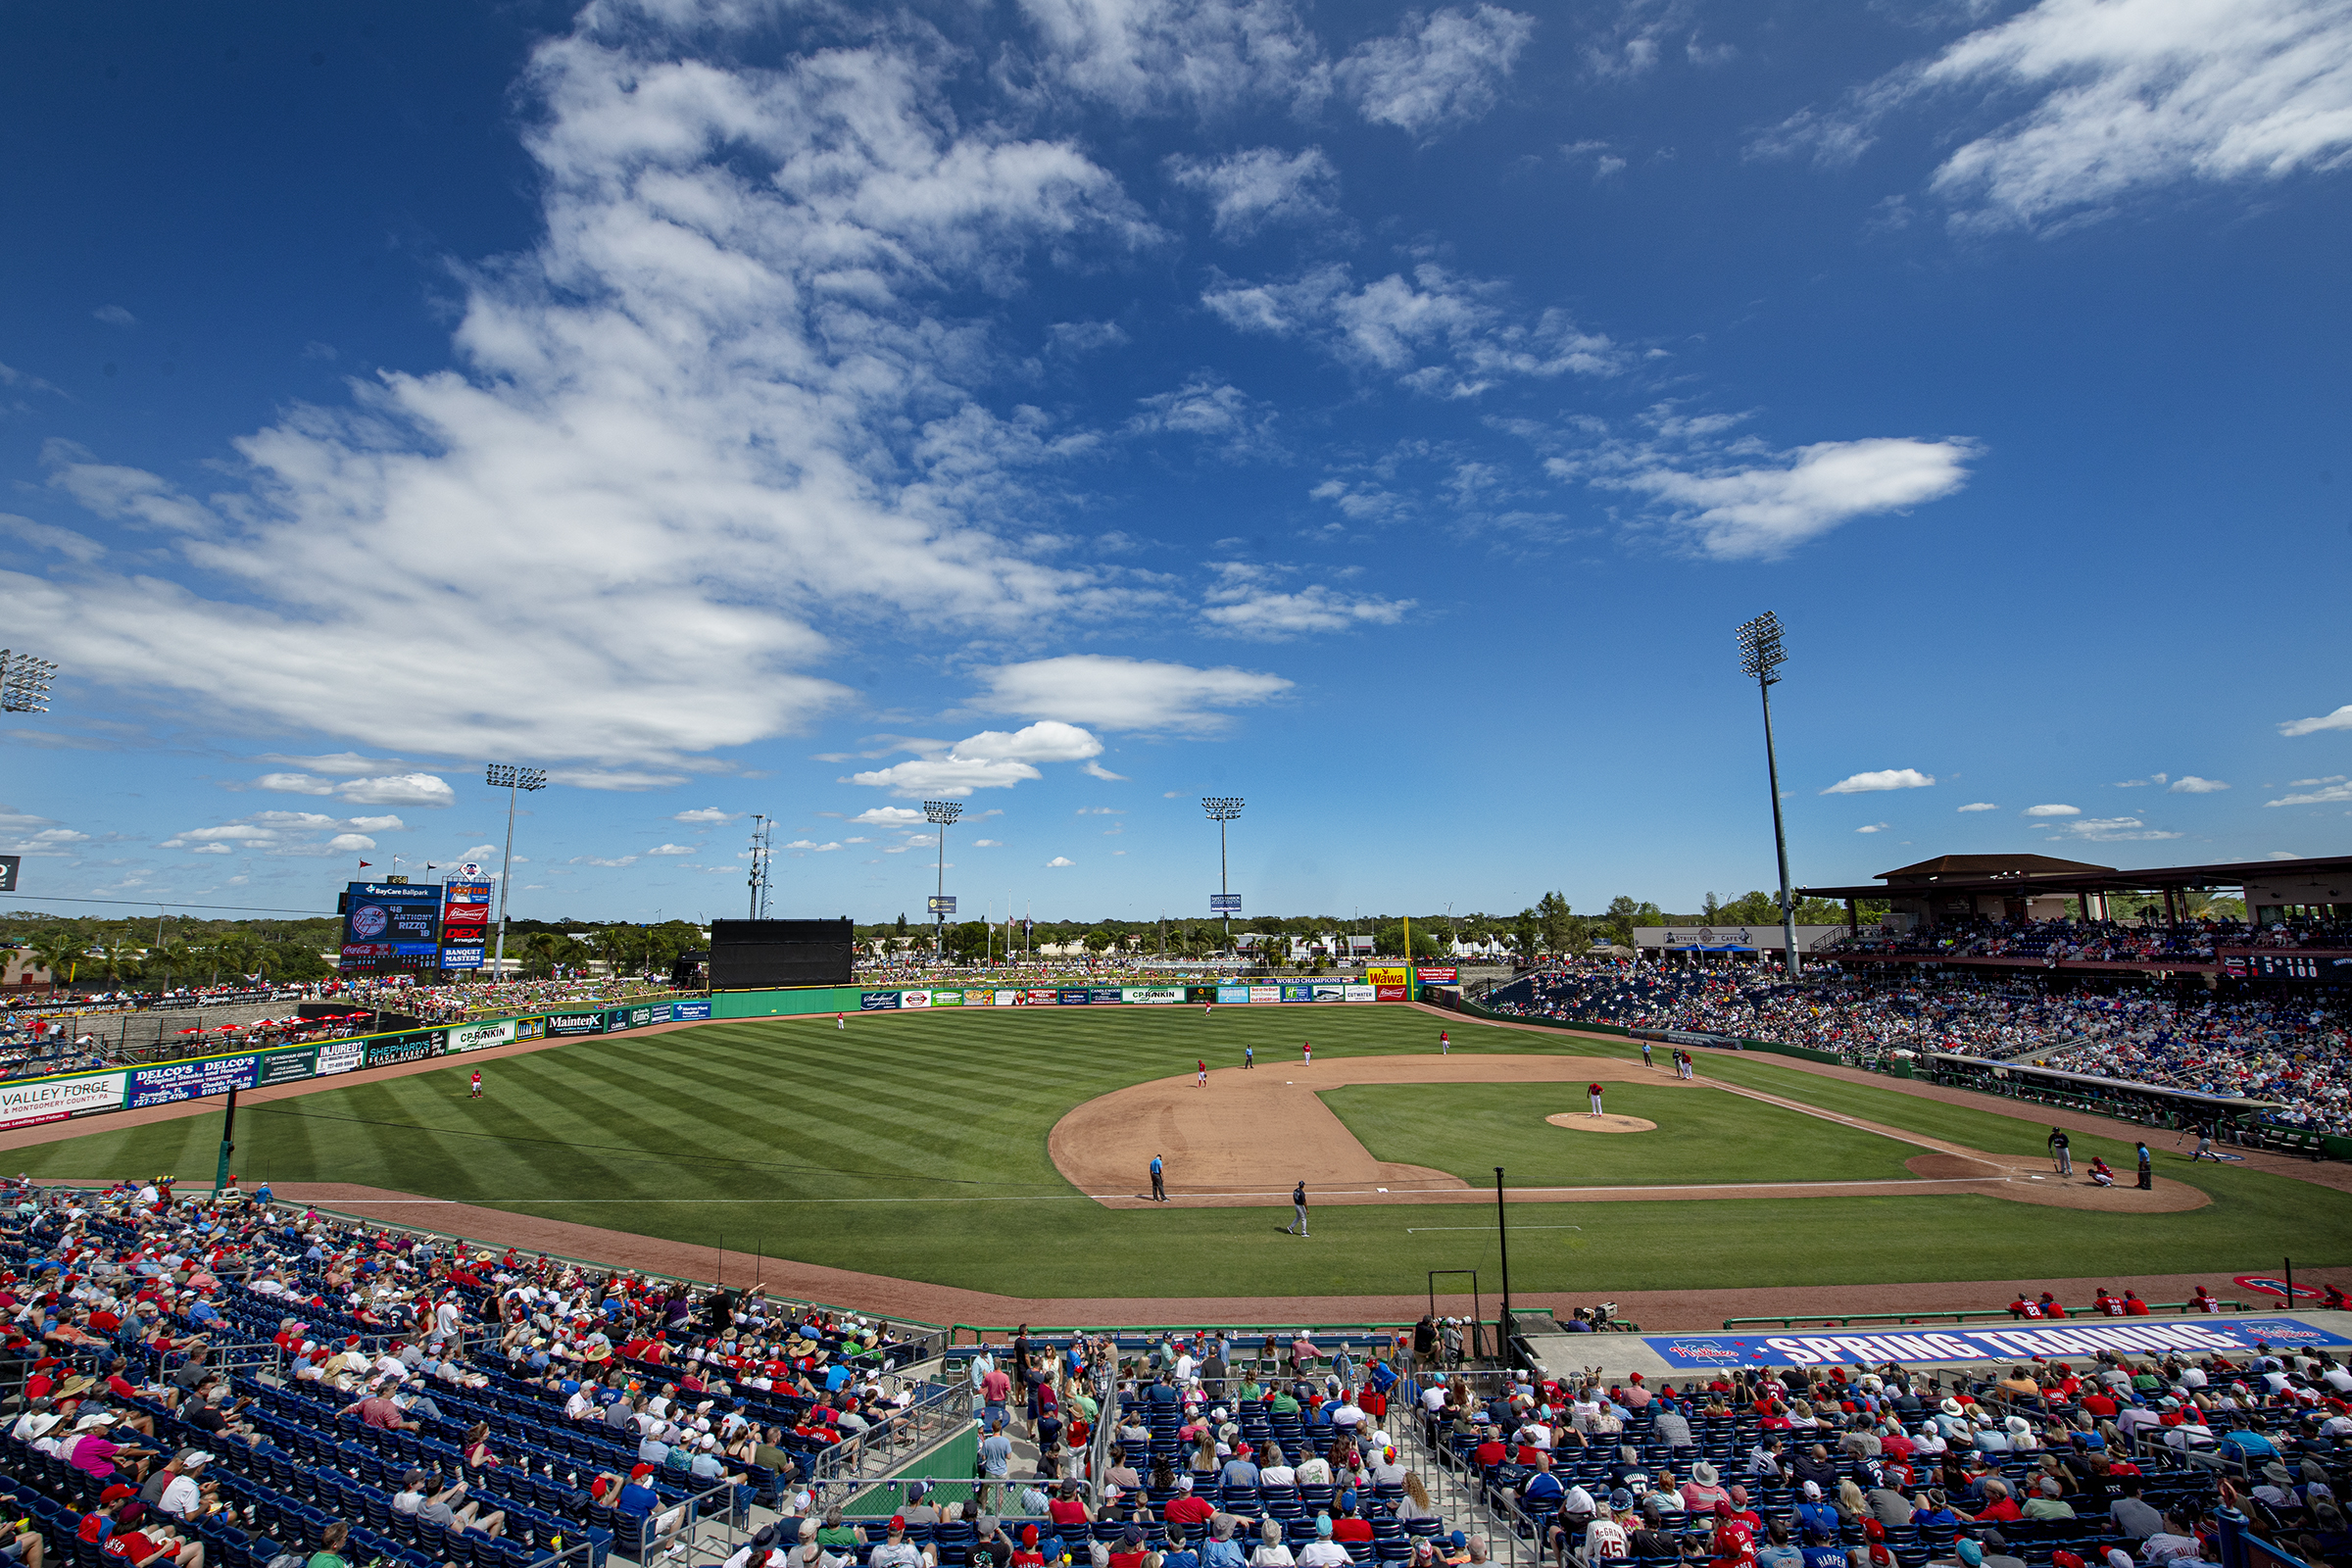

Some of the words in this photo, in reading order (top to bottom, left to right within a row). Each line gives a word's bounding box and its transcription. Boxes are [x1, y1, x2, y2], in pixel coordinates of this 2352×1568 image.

[375, 888, 402, 897] BayCare
[403, 888, 429, 897] Ballpark
[398, 921, 427, 930] RIZZO
[445, 928, 482, 939] DEX
[2249, 956, 2256, 965] 2
[2266, 962, 2274, 973] 5
[2287, 965, 2294, 977] 1
[2298, 965, 2306, 977] 0
[2309, 965, 2318, 977] 0
[1369, 973, 1404, 984] Wawa
[17, 1006, 61, 1017] CONSUMING
[549, 1013, 603, 1029] MaintenX
[319, 1042, 364, 1057] INJURED?
[369, 1040, 430, 1058] SHEPHARD'S
[461, 1044, 483, 1053] ROOFING
[368, 1054, 396, 1063] BEACH
[400, 1049, 430, 1058] RESORT
[375, 1056, 407, 1066] CLEARWATER
[135, 1065, 194, 1082] DELCO'S
[204, 1056, 256, 1072] DELCO'S
[144, 1076, 176, 1086] Original
[178, 1073, 203, 1082] Steaks
[220, 1066, 248, 1076] Hoagies
[166, 1079, 205, 1089] PHILADELPHIA
[206, 1074, 233, 1083] TRADITION
[2, 1087, 61, 1106] VALLEY
[64, 1080, 110, 1098] FORGE
[12, 1100, 64, 1113] MONTGOMERY
[67, 1094, 97, 1105] COUNTY,
[12, 1116, 35, 1126] Leading
[390, 1315, 398, 1328] 5
[1765, 1332, 1990, 1364] SPRING
[1970, 1324, 2248, 1362] TRAINING
[1669, 1345, 1740, 1359] Phillies
[1874, 1469, 1885, 1487] 2
[1632, 1482, 1647, 1494] 51
[1599, 1540, 1623, 1558] 45
[1817, 1554, 1846, 1568] HARPER
